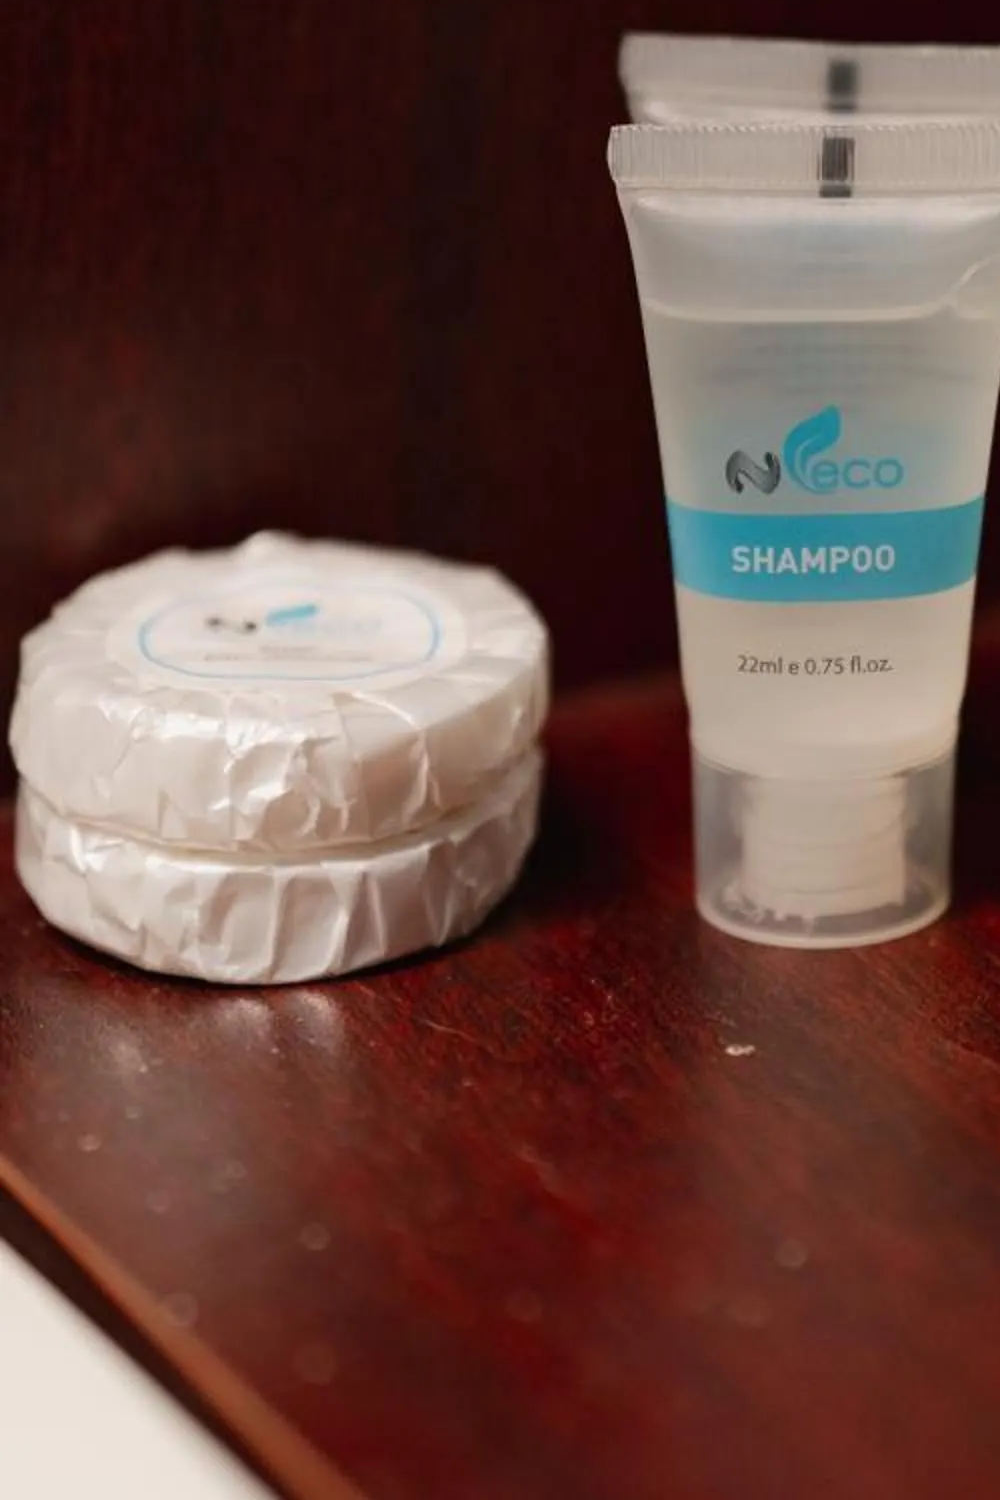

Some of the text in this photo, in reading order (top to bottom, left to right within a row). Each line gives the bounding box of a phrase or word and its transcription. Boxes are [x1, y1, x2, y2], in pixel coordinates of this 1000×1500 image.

[810, 458, 905, 490] eco
[731, 544, 896, 574] SHAMPOO
[736, 654, 783, 674] 22ml
[804, 657, 845, 676] 0.75
